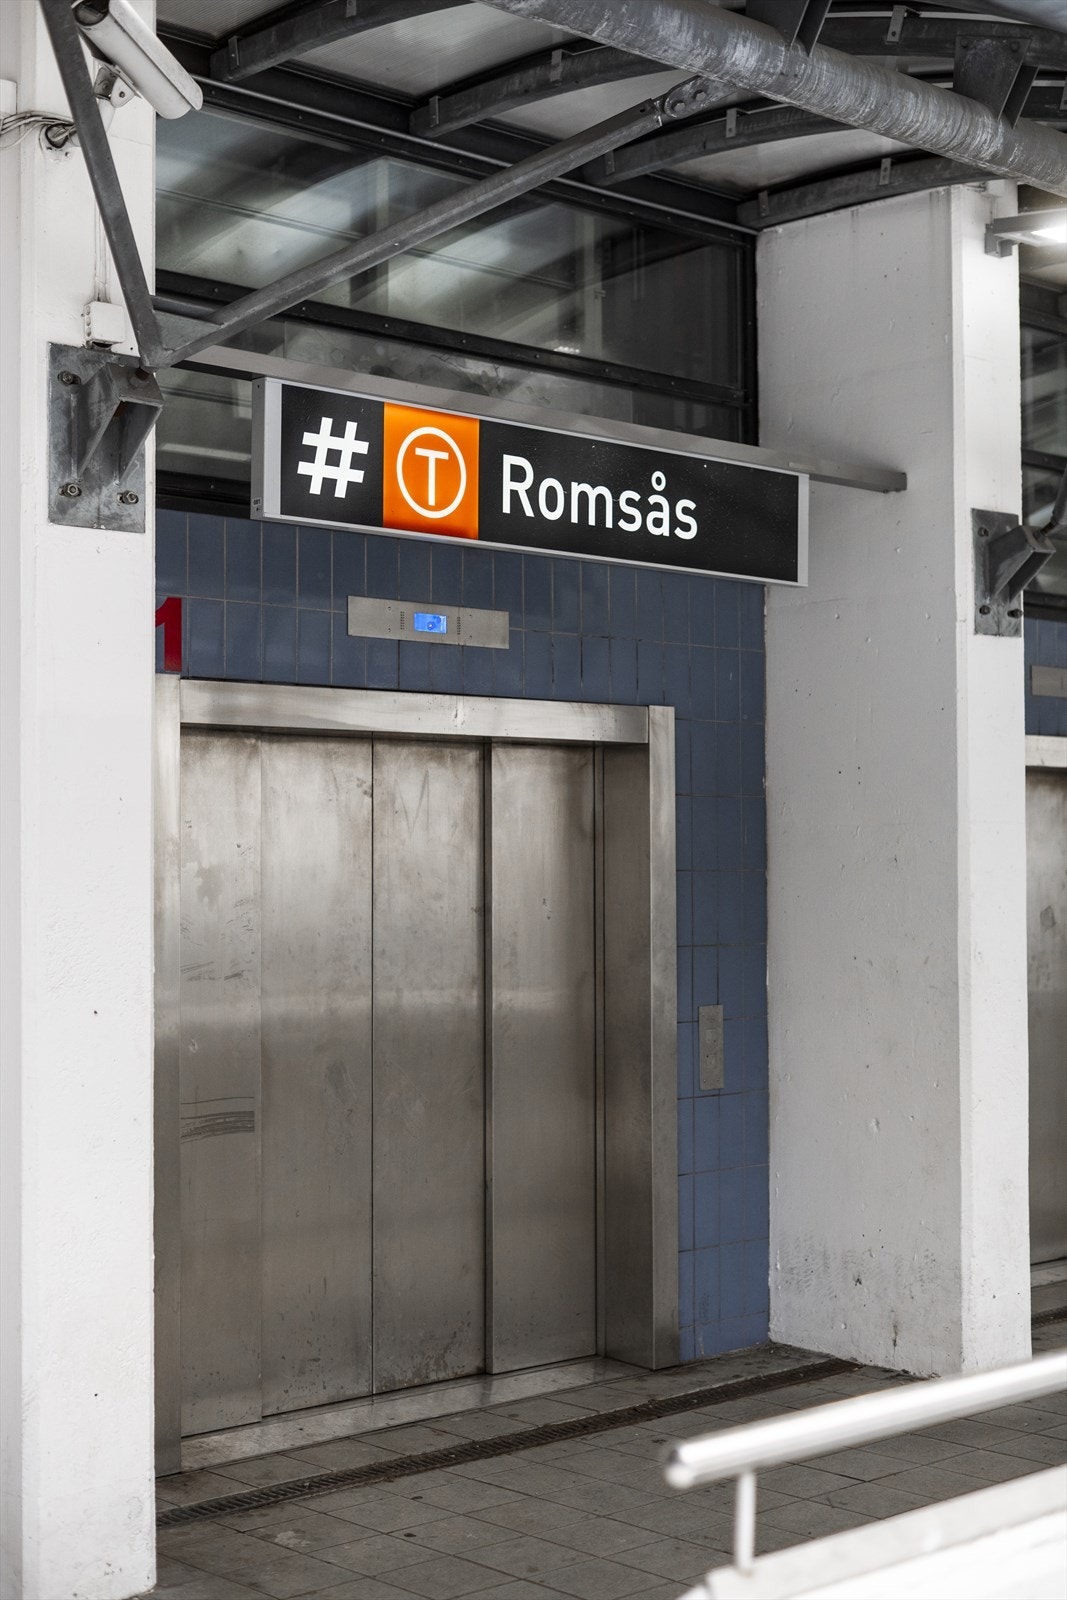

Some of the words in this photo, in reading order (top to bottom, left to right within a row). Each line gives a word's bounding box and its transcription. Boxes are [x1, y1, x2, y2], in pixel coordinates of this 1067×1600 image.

[415, 447, 449, 507] T
[502, 454, 699, 541] Romsås
[155, 596, 182, 672] 1
